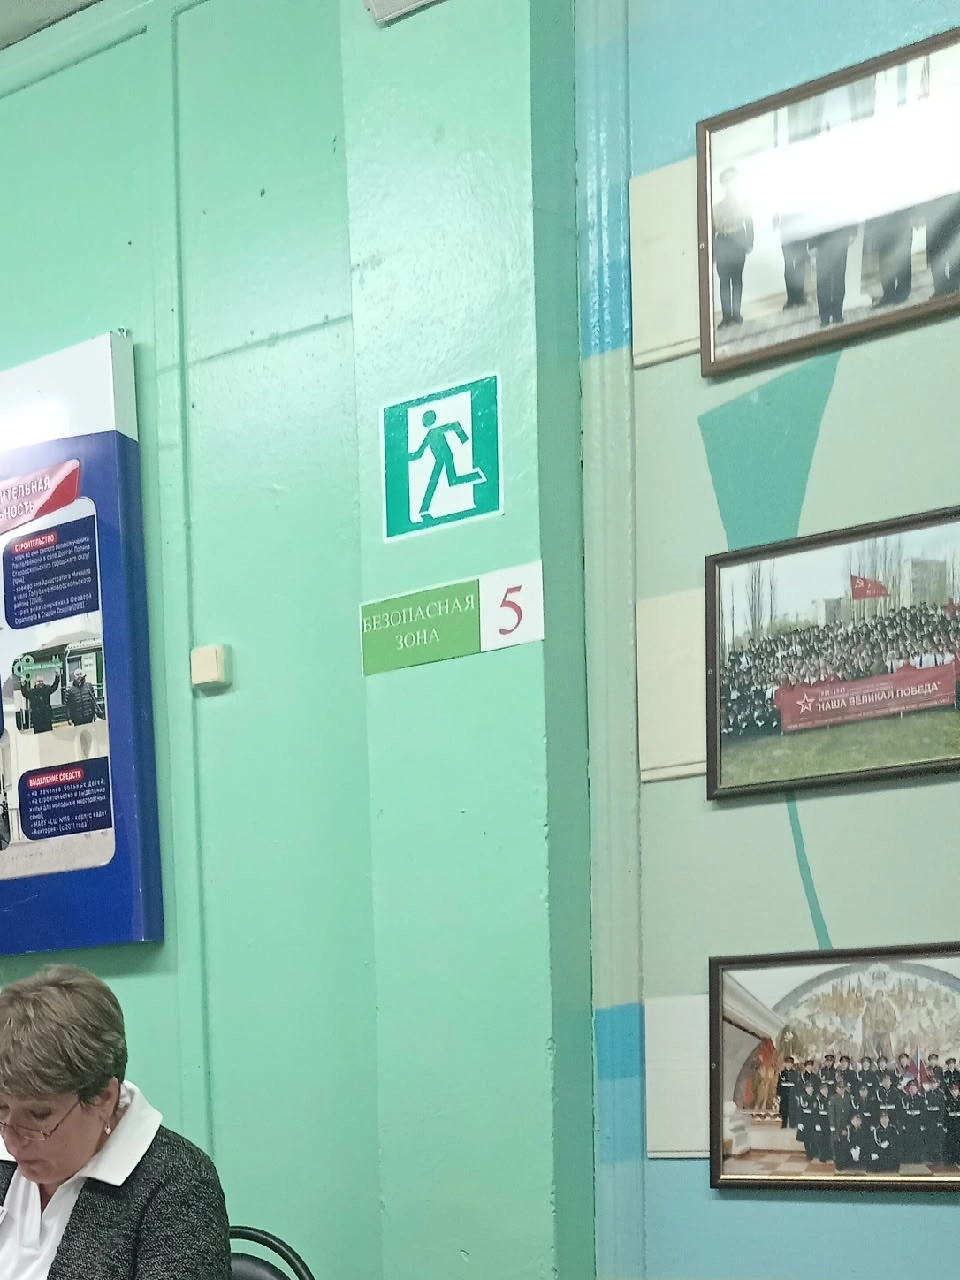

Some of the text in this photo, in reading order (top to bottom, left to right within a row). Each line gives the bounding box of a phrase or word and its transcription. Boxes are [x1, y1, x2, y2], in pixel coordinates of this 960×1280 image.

[362, 593, 476, 633] БЕЗОПАСНАЯ
[498, 585, 523, 635] 5
[395, 627, 440, 651] ЗОНА
